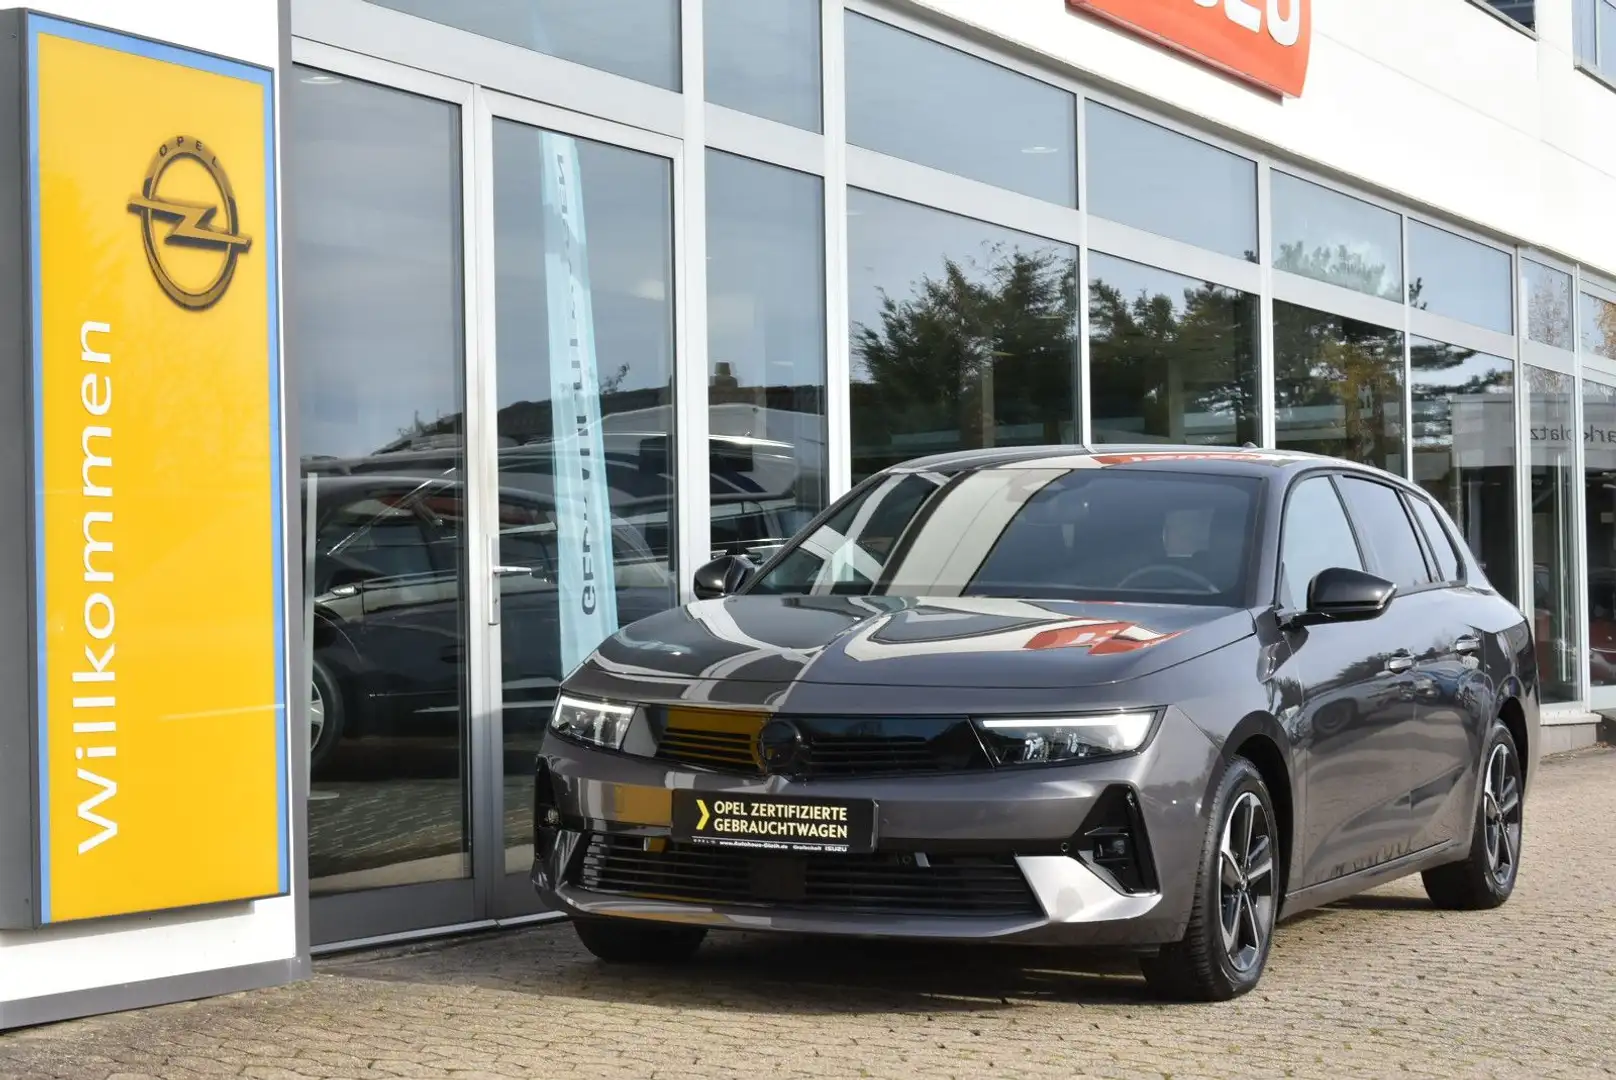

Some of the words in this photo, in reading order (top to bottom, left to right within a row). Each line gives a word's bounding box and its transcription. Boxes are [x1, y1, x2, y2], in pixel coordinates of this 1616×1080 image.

[159, 136, 218, 168] OPEL
[72, 320, 118, 855] Willkommen
[713, 800, 748, 816] OPEL
[750, 803, 848, 821] ZERTIFIZIERTE
[713, 818, 848, 838] GEBRAUCHTWAGEN
